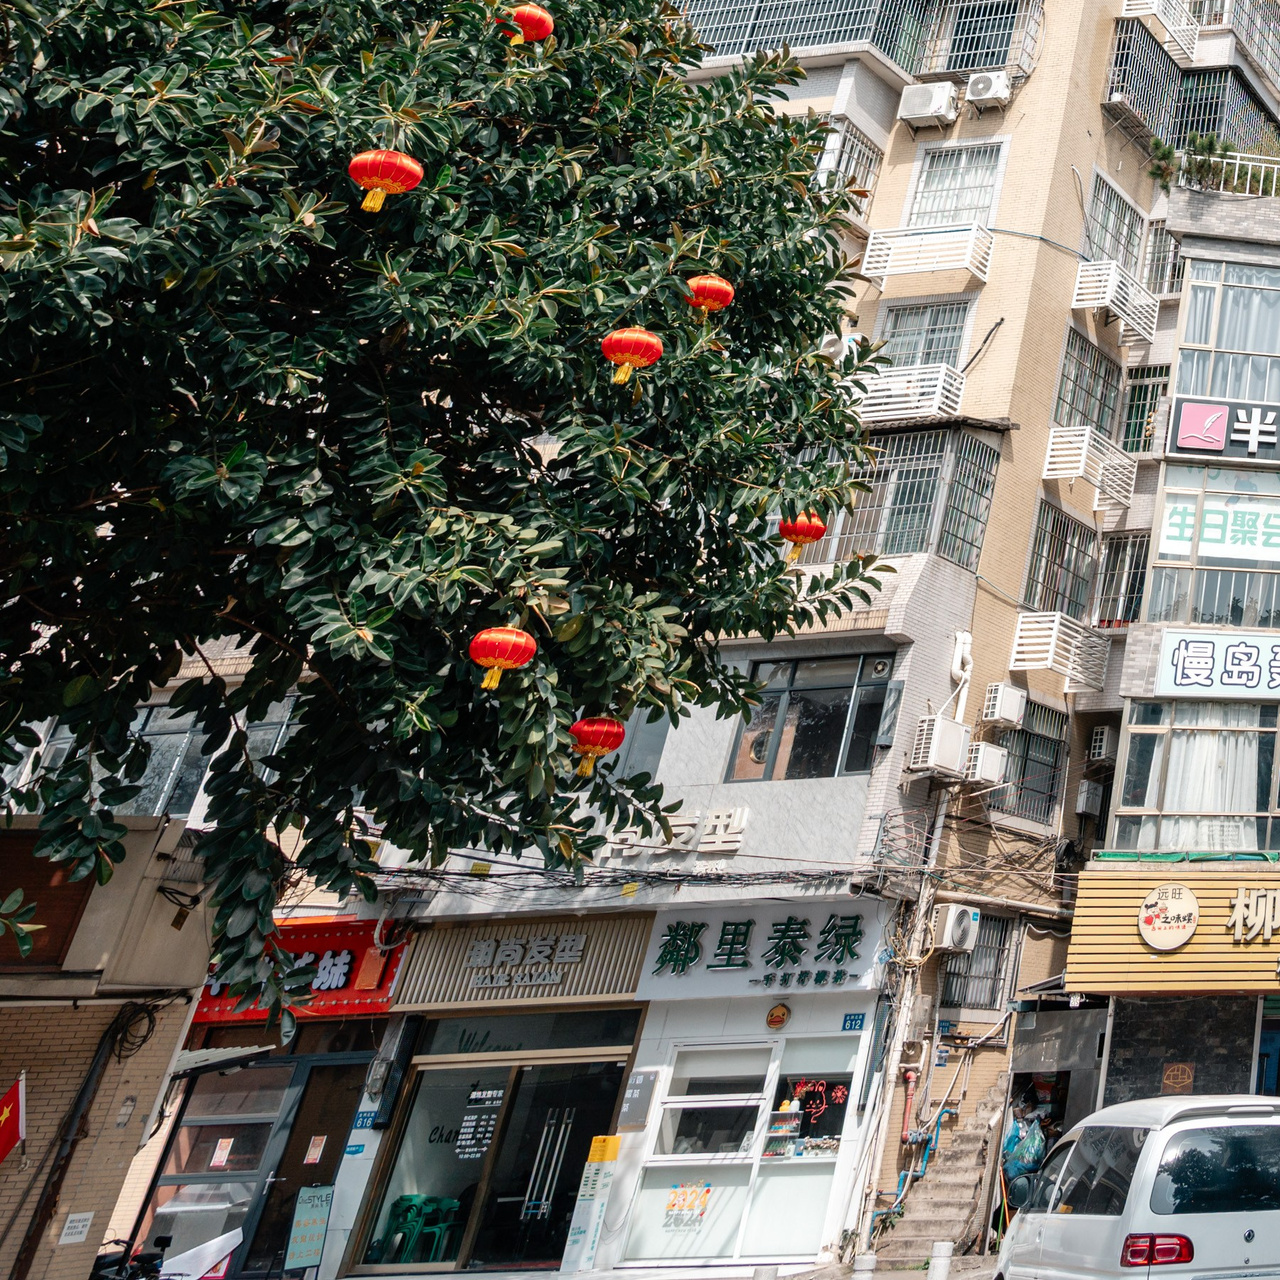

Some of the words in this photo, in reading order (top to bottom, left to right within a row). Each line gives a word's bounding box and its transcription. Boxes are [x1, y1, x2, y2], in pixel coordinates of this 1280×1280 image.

[1157, 887, 1184, 901] 远旺
[466, 933, 588, 968] 潮尚发型
[471, 973, 511, 988] HAIR
[512, 970, 565, 986] SALON
[845, 1020, 861, 1030] 612
[357, 1117, 372, 1127] 616
